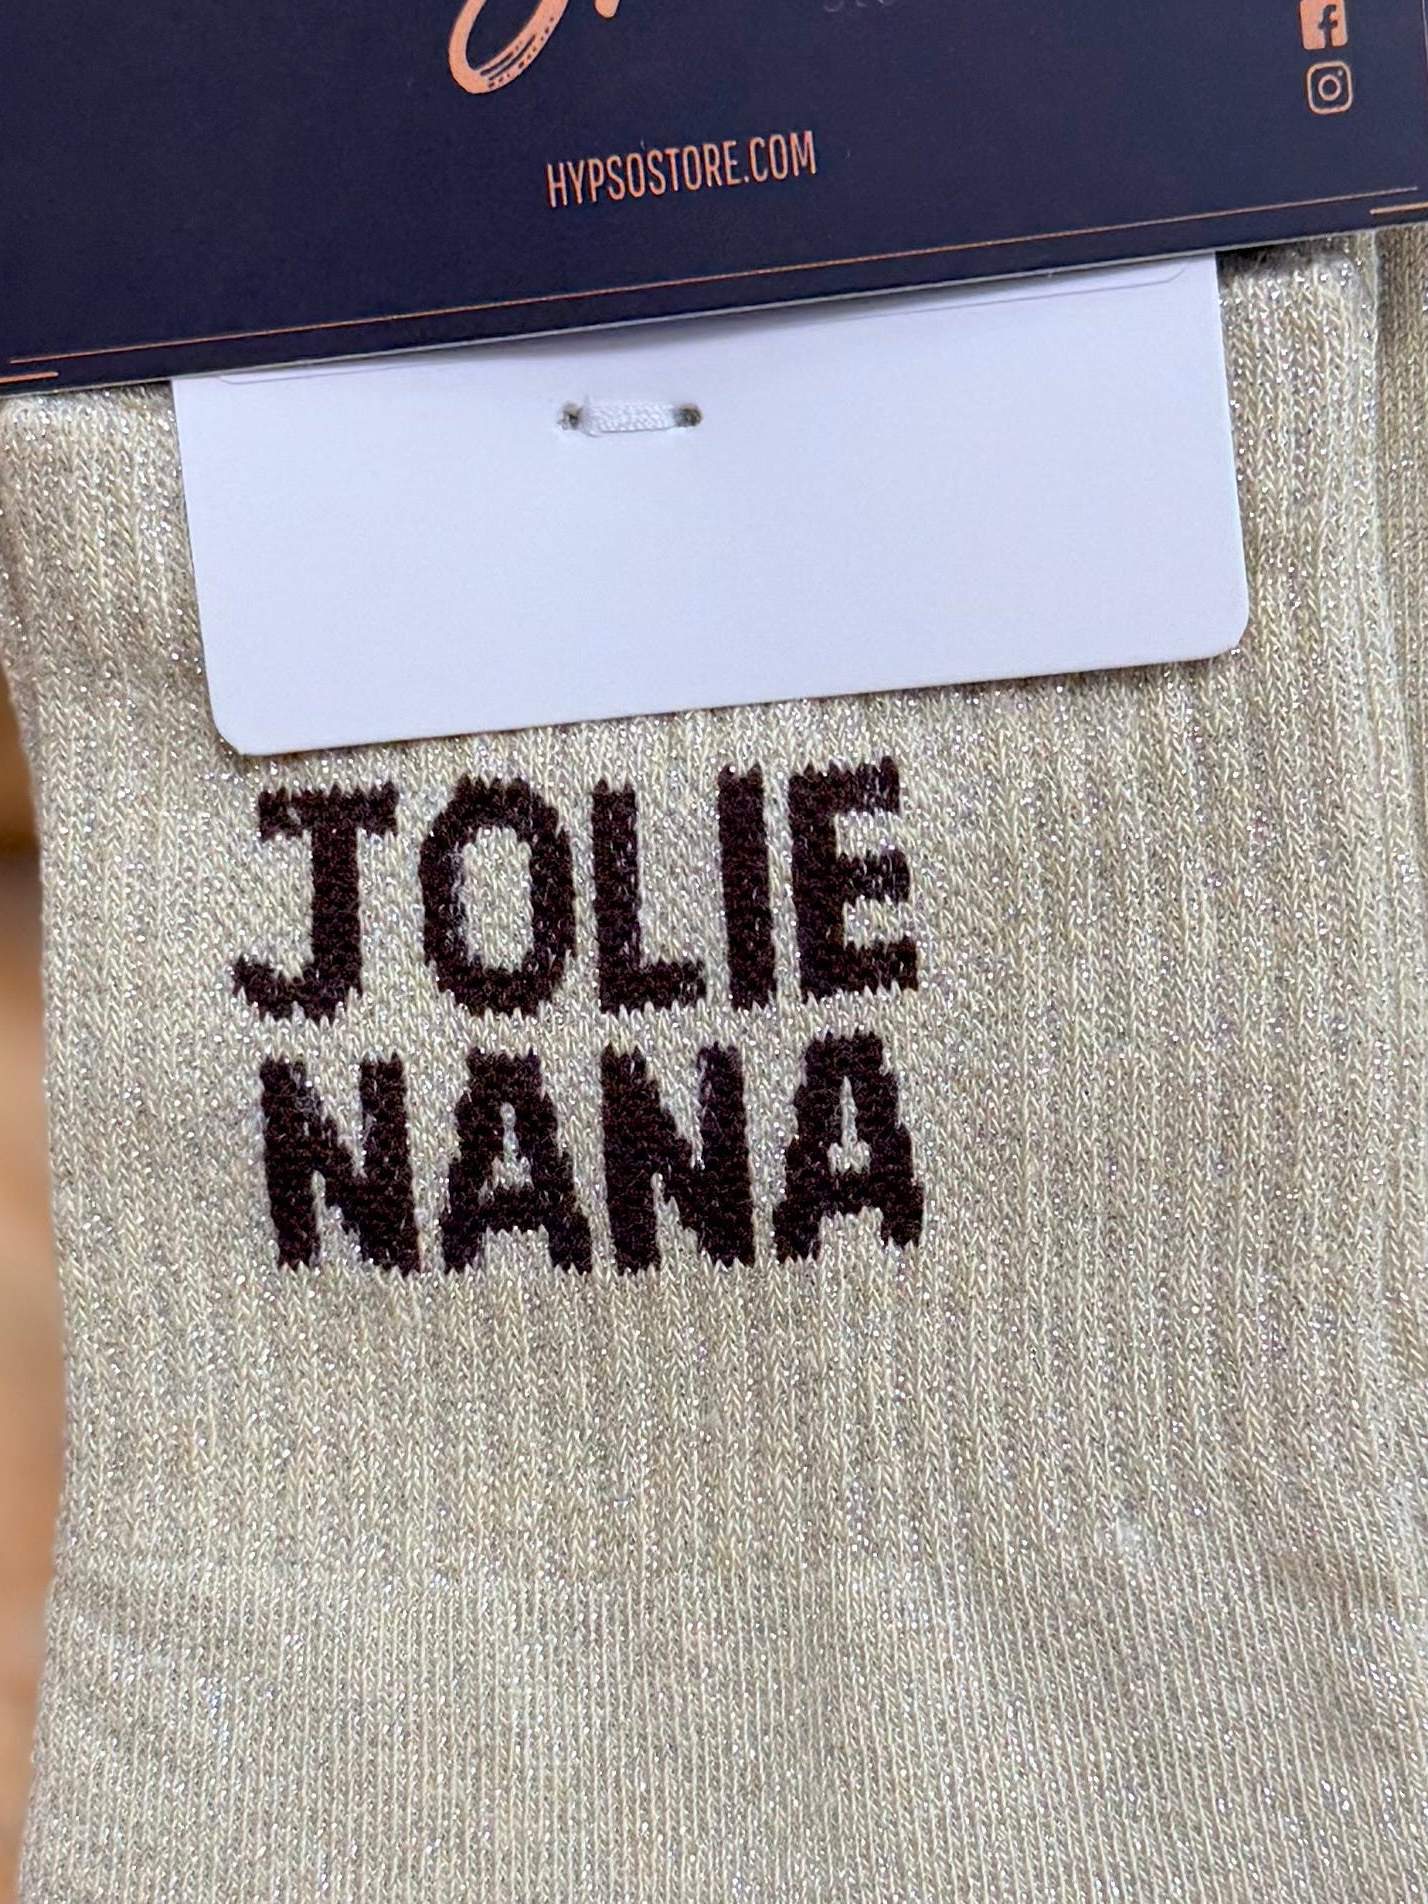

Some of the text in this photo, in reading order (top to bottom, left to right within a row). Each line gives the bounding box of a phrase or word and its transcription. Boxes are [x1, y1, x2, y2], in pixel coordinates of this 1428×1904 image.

[546, 129, 818, 209] HYPSOSTORE.COM
[232, 755, 920, 1023] JOLIE
[258, 1028, 926, 1276] NANA
